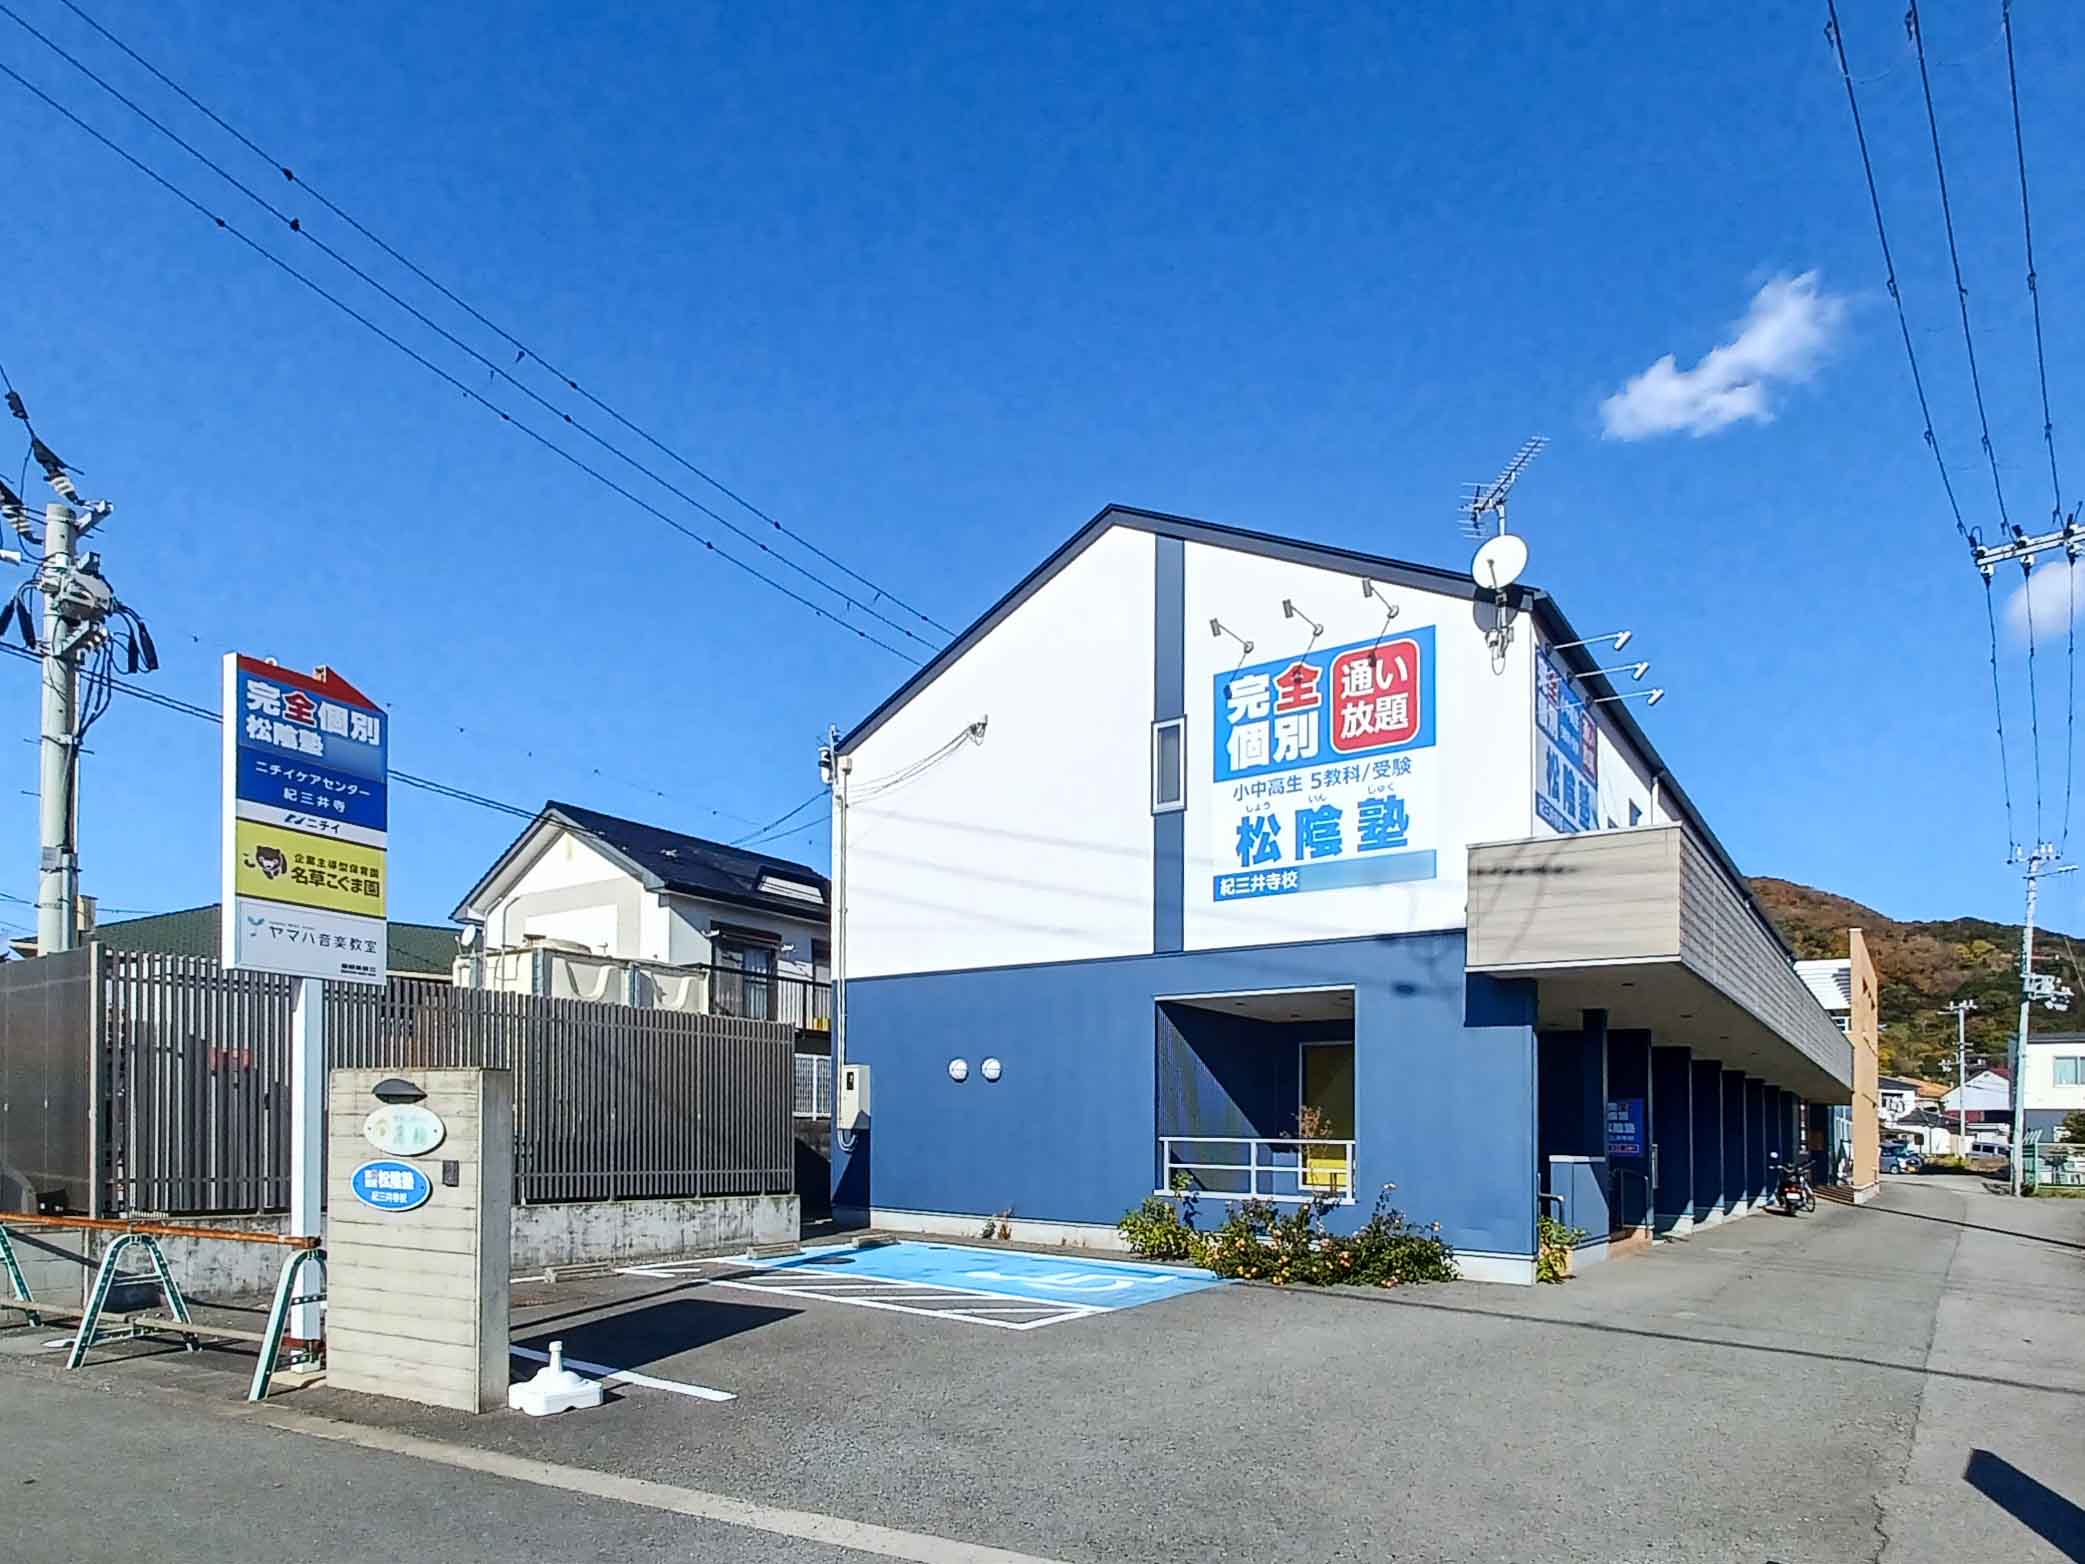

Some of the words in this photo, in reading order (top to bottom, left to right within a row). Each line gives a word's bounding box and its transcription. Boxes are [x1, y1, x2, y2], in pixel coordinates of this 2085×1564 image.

[1225, 660, 1323, 723] 完全
[1340, 655, 1409, 700] 通い
[246, 679, 381, 747] 完全個別
[1340, 692, 1409, 740] 放題
[246, 714, 324, 757] 松陰塾
[1226, 711, 1319, 773] 個別
[255, 760, 371, 797] ニチイケアセンター
[1233, 774, 1303, 802] 小中高生
[1310, 757, 1412, 790] 5教科/受験
[1245, 802, 1271, 813] しょう
[1308, 793, 1327, 803] いん
[1367, 782, 1395, 795] じゅく
[283, 787, 346, 814] 紀三井寺
[307, 818, 341, 834] ニチイ
[1235, 794, 1410, 867] 松陰塾
[290, 866, 380, 898] 名草こぐま園
[1219, 871, 1299, 897] 紀三井寺校
[268, 924, 378, 955] ヤマハ音楽教室
